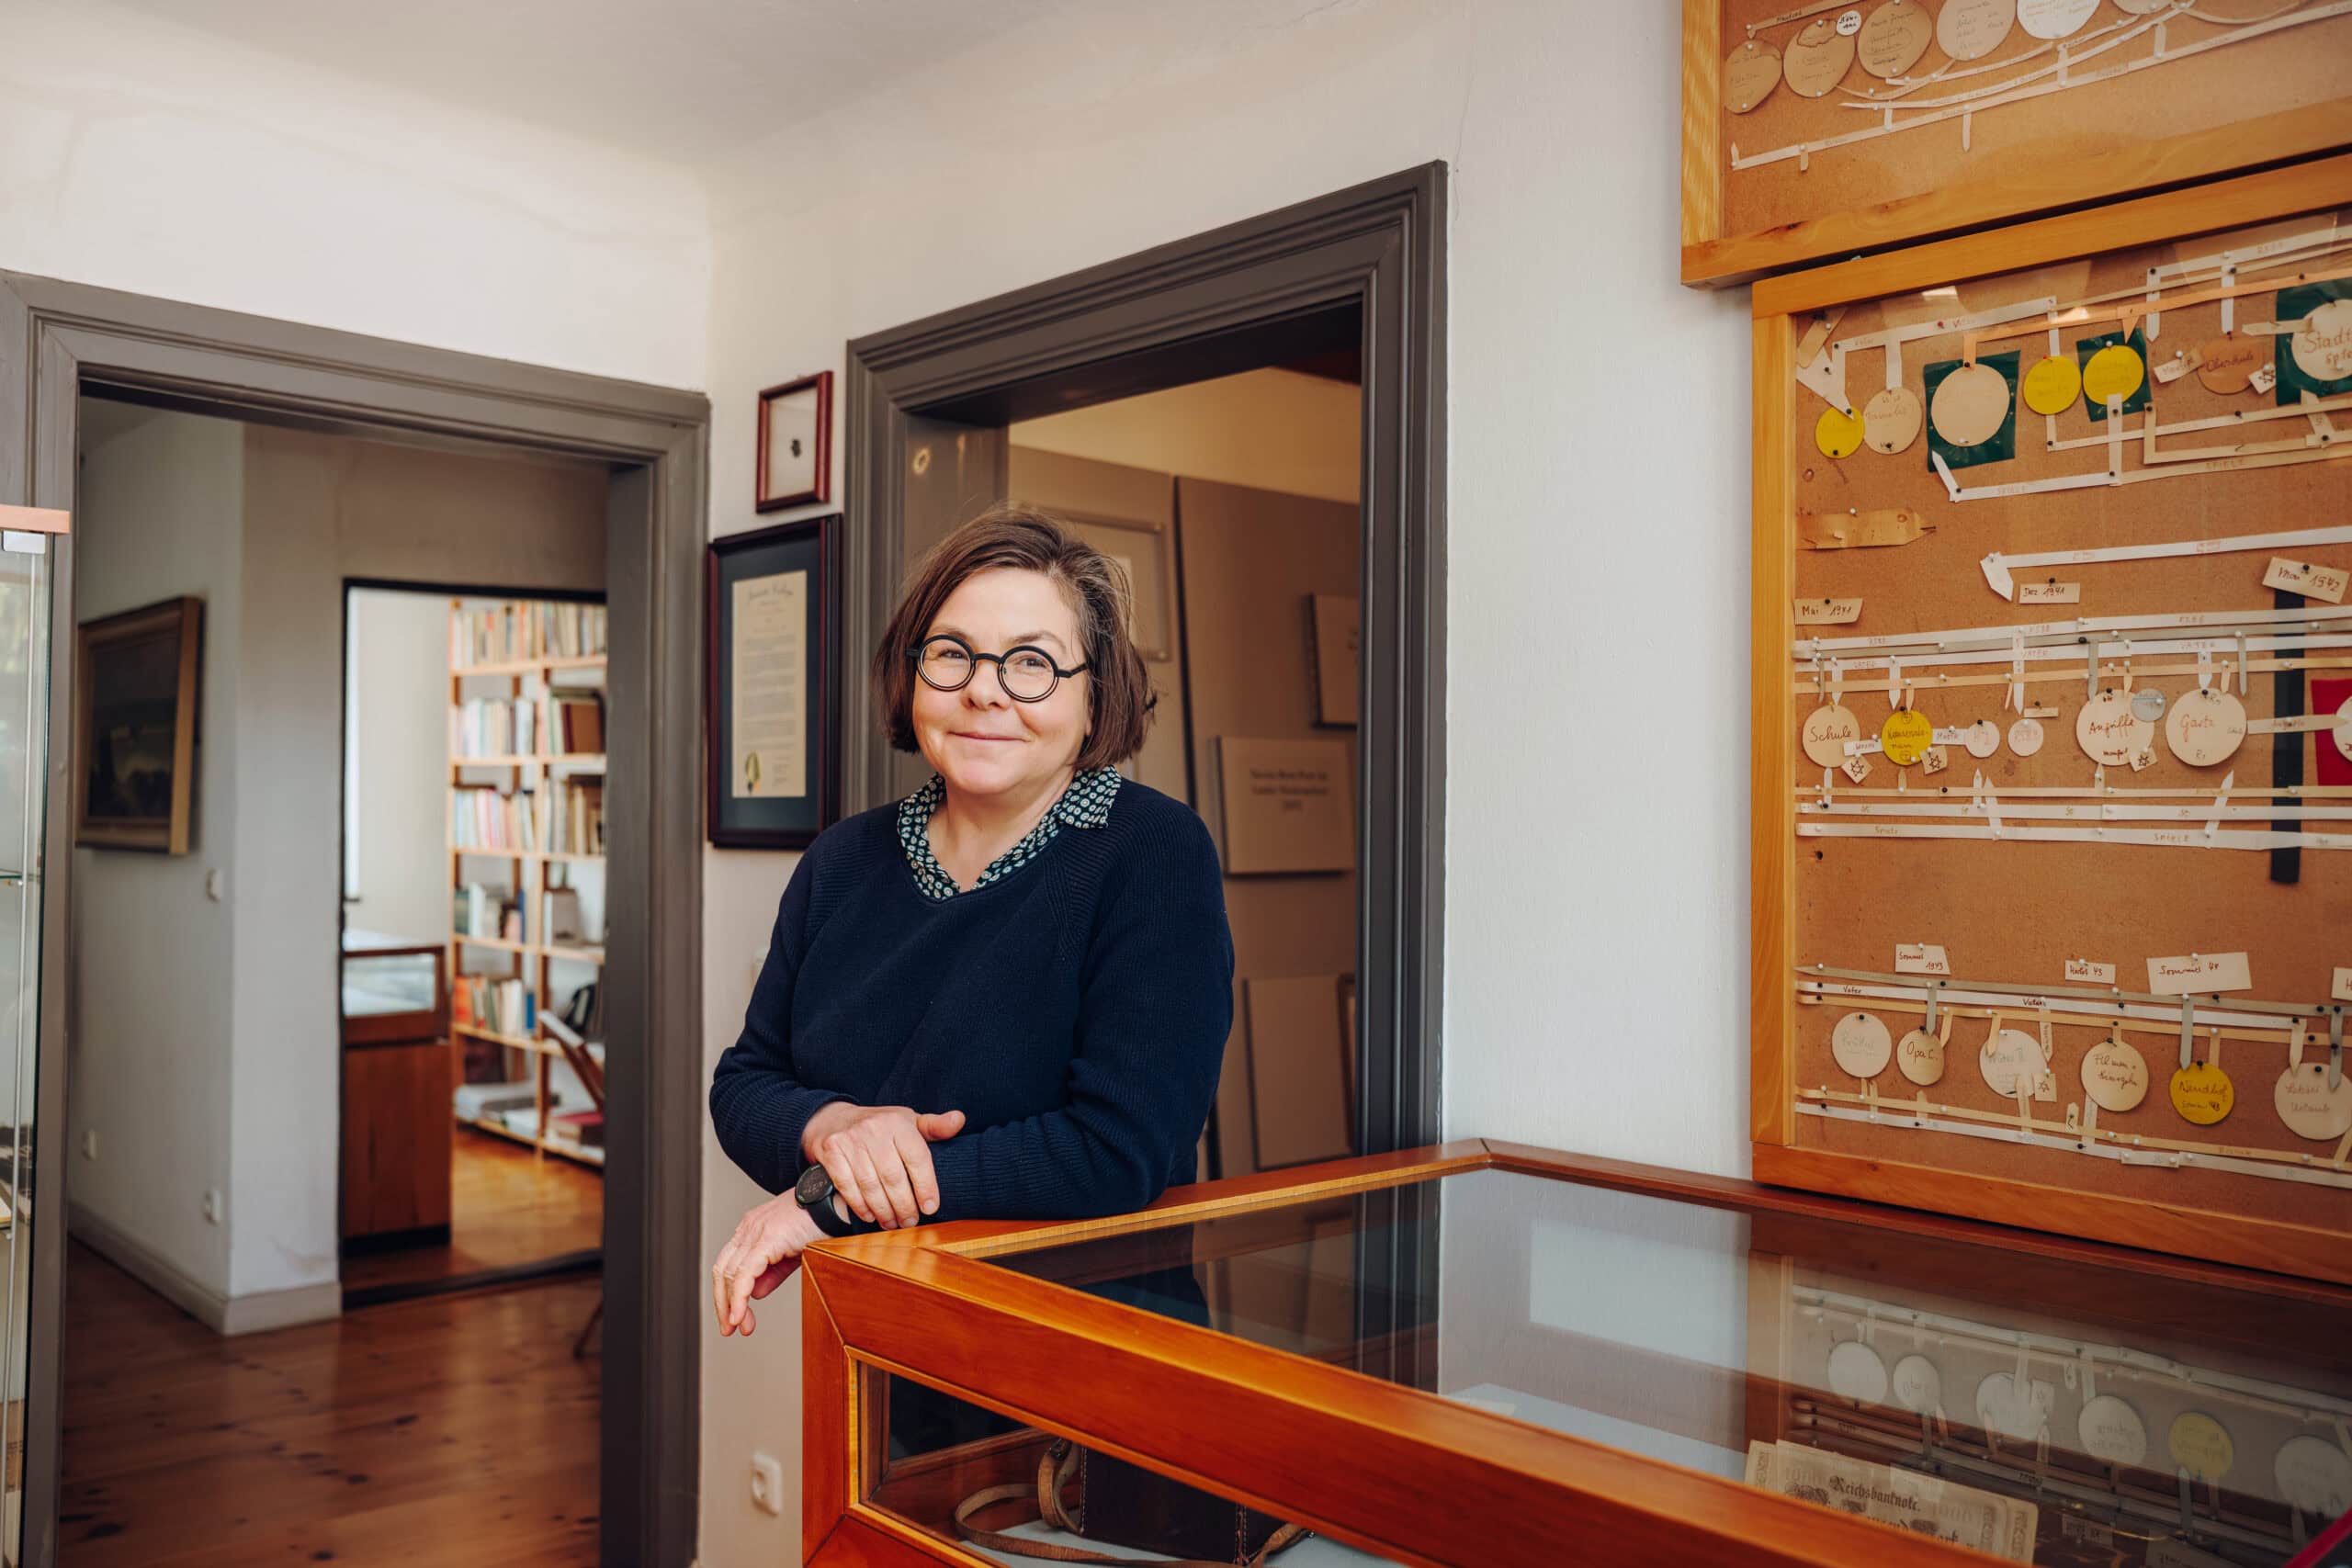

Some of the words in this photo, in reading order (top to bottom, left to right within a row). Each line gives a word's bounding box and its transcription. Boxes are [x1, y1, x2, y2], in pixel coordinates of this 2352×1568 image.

[1802, 606, 1819, 617] Mai
[1808, 725, 1852, 743] Schule
[1926, 962, 1944, 971] 1943
[2093, 966, 2103, 976] 43
[1843, 985, 1862, 994] Vater
[1906, 1041, 1927, 1065] Opa
[1828, 1474, 1922, 1513] Reichsbanknote.
